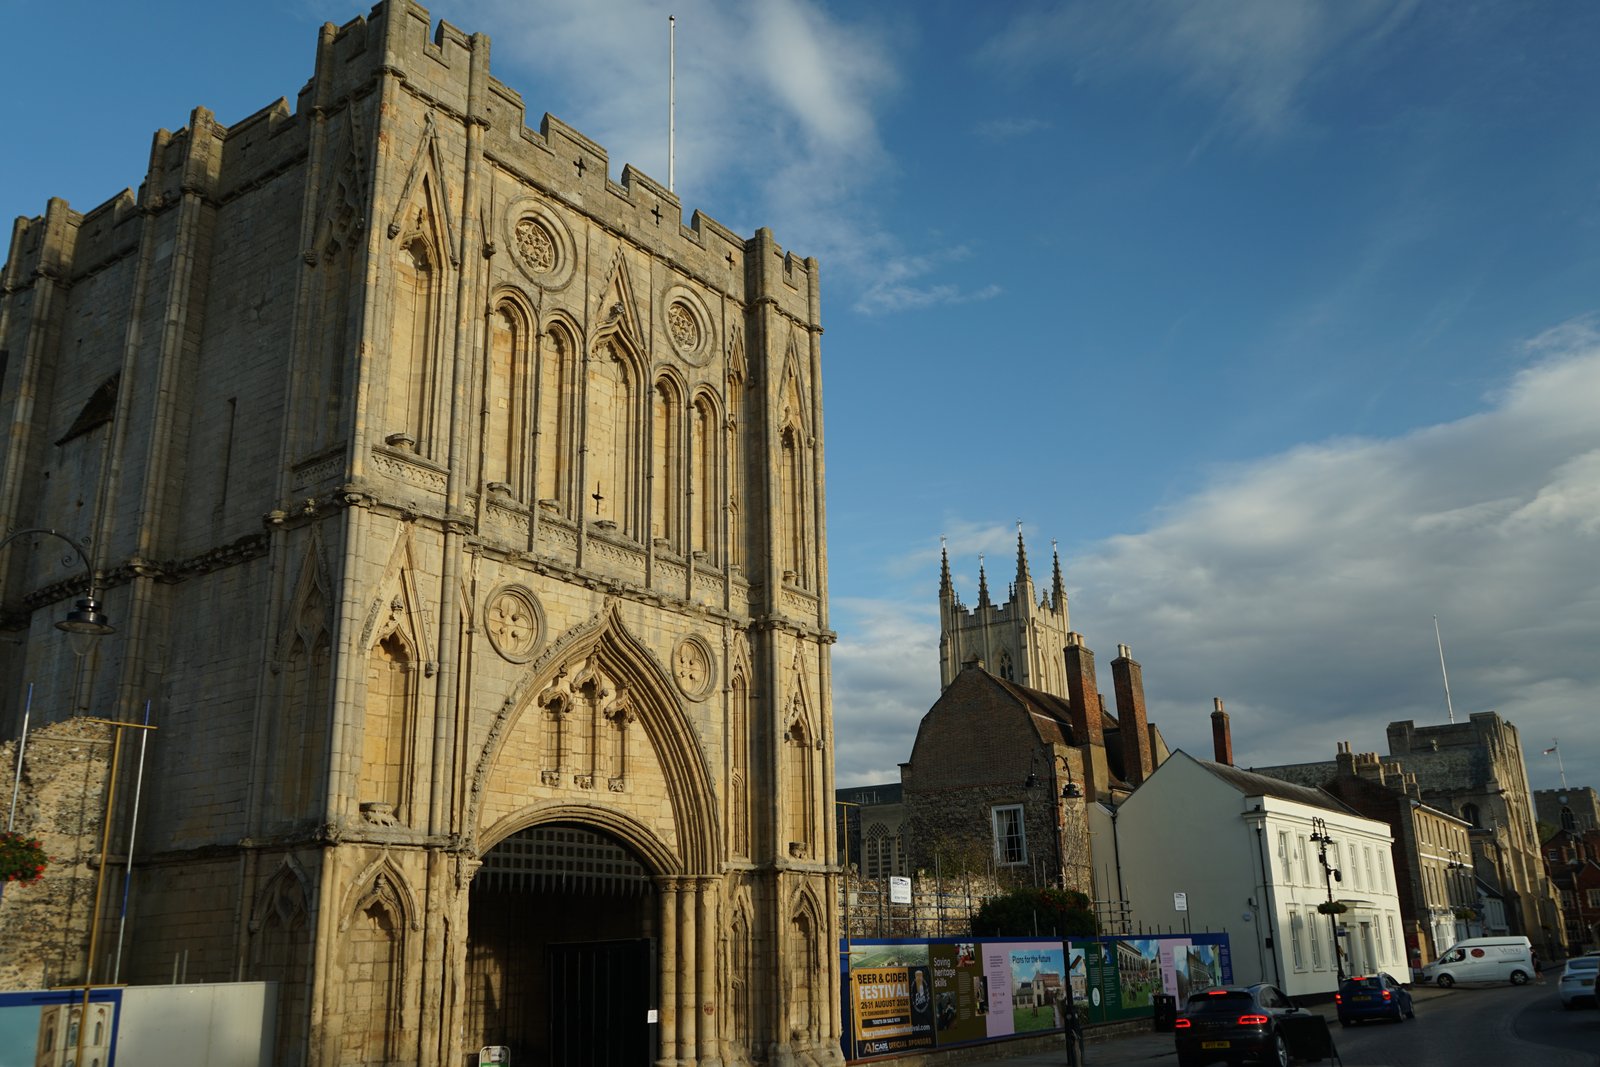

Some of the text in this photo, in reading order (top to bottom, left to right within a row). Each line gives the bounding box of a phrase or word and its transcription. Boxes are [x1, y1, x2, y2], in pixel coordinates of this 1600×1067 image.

[933, 957, 951, 968] Saving
[1012, 955, 1024, 964] Plans
[1038, 954, 1051, 963] future
[857, 972, 907, 984] BEER & CIDER
[934, 967, 956, 978] heritage
[935, 977, 947, 988] skills
[860, 984, 909, 1000] FESTIVAL
[875, 999, 895, 1008] AUGUST
[888, 1041, 907, 1050] OFFICIAL
